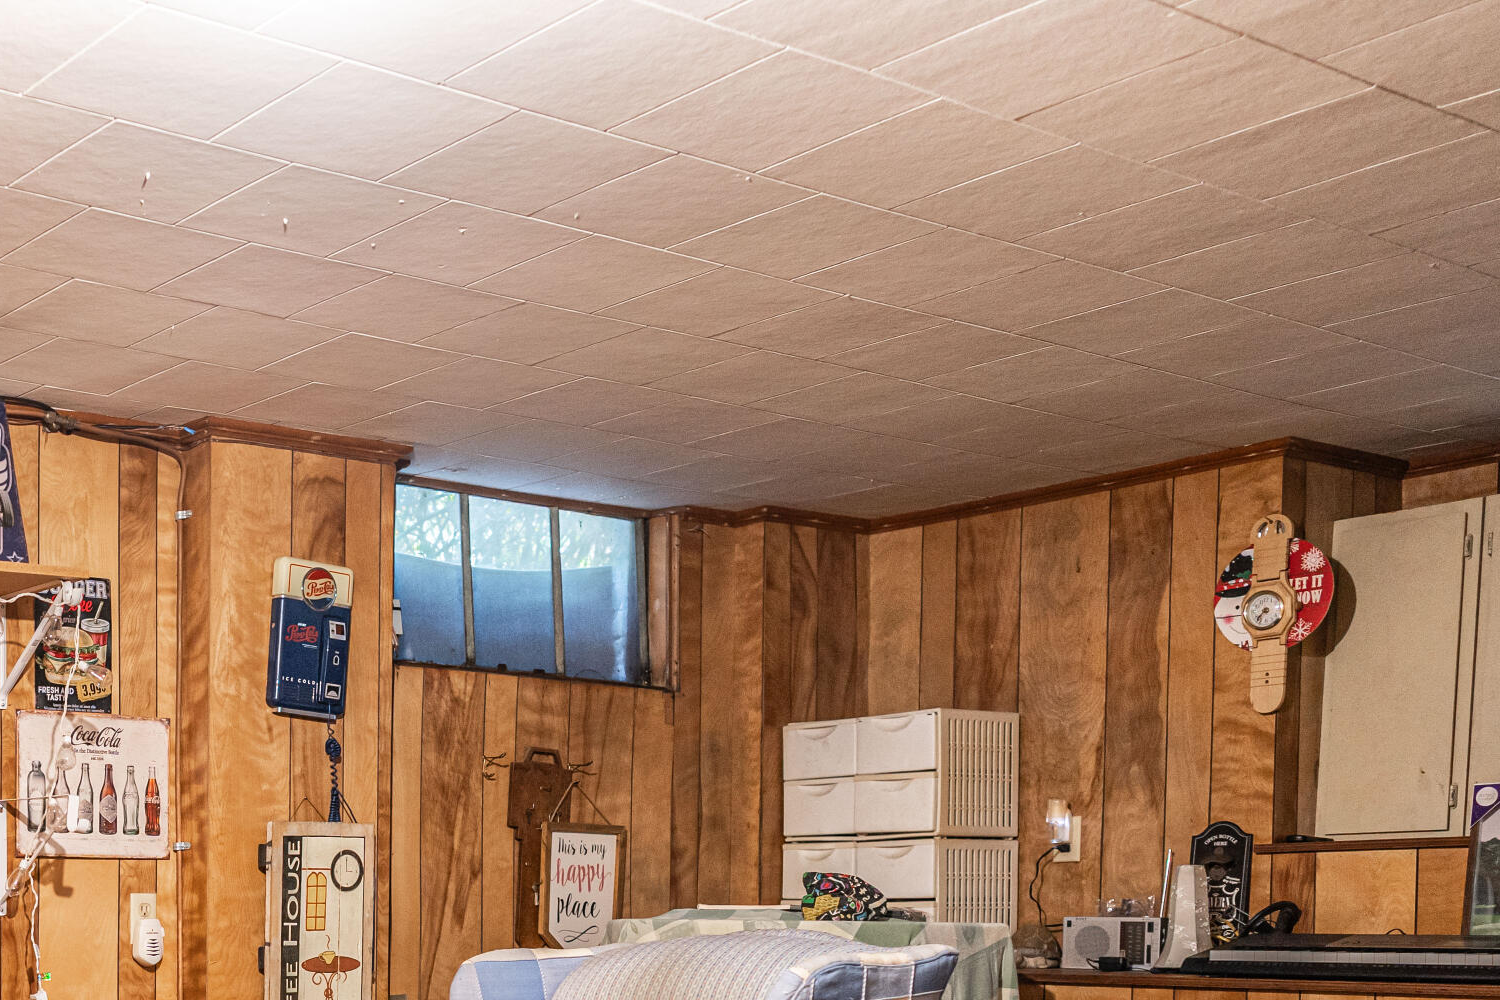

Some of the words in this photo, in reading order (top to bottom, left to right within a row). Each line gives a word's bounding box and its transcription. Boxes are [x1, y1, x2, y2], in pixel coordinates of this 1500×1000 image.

[1311, 574, 1324, 588] IT
[38, 686, 60, 694] FRESH
[60, 687, 75, 695] AD
[70, 725, 124, 749] Coca-Cola
[580, 840, 588, 856] is
[591, 842, 607, 860] my
[550, 858, 613, 893] happy
[283, 840, 301, 947] HOUSE
[556, 893, 600, 923] place
